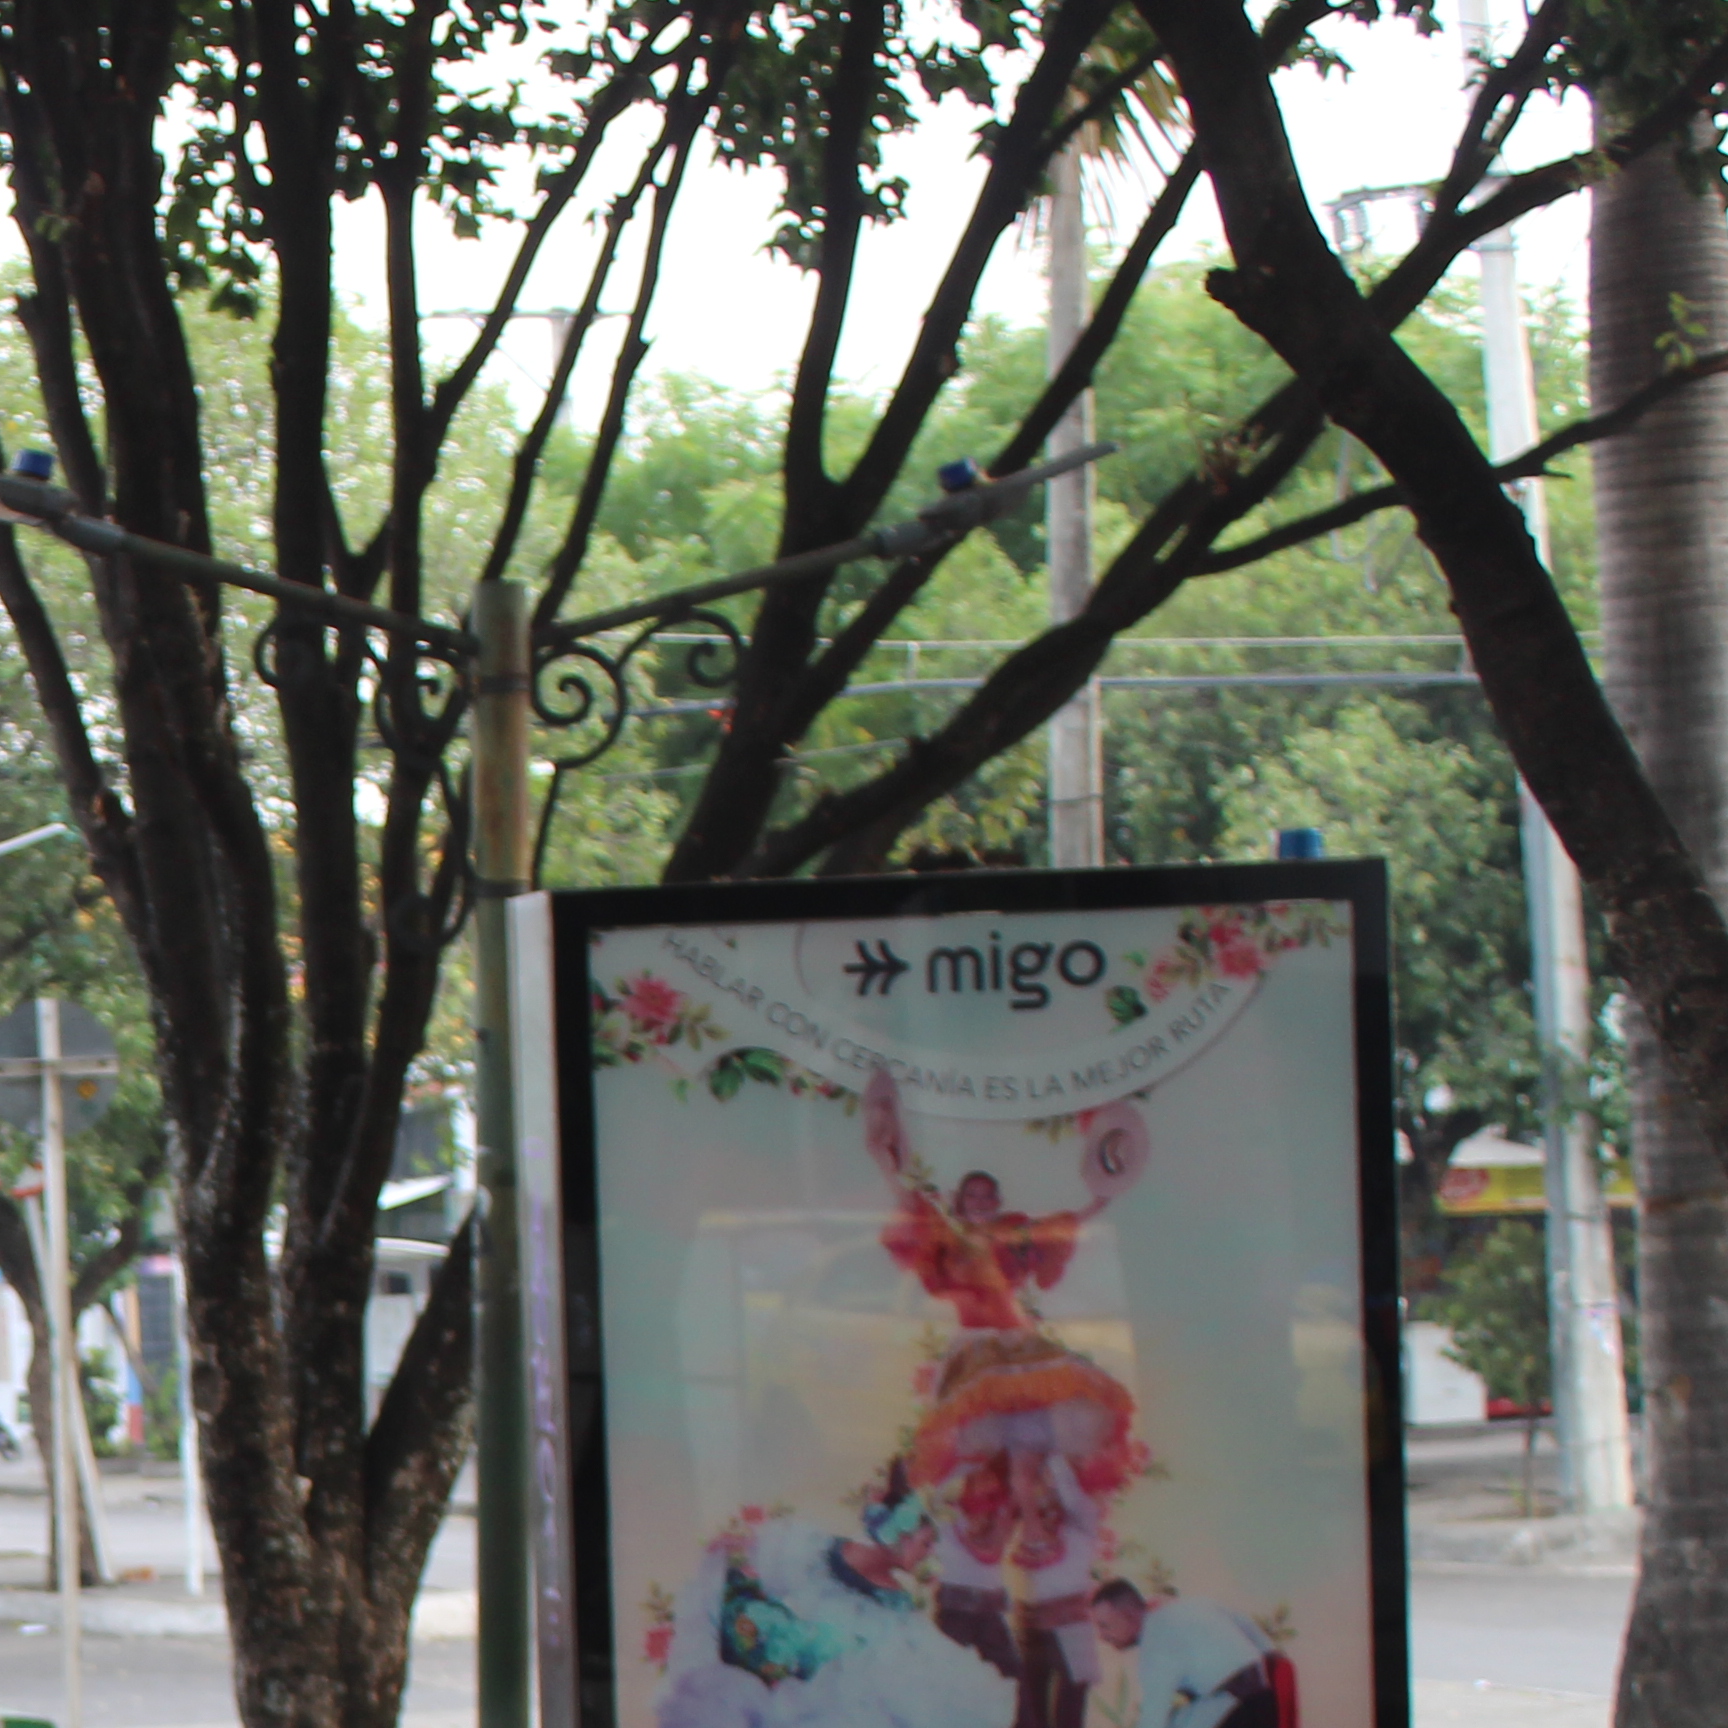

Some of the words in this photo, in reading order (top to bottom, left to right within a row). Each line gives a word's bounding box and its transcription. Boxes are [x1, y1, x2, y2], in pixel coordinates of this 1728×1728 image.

[662, 930, 766, 1014] HABLAR
[765, 999, 828, 1052] CON
[831, 1035, 976, 1102] CERCANÍA
[983, 1075, 1020, 1102] ES
[1026, 1072, 1065, 1100] LA
[1072, 1033, 1170, 1094] MEJOR
[1168, 980, 1232, 1044] RUTA
[926, 930, 1108, 1011] migo
